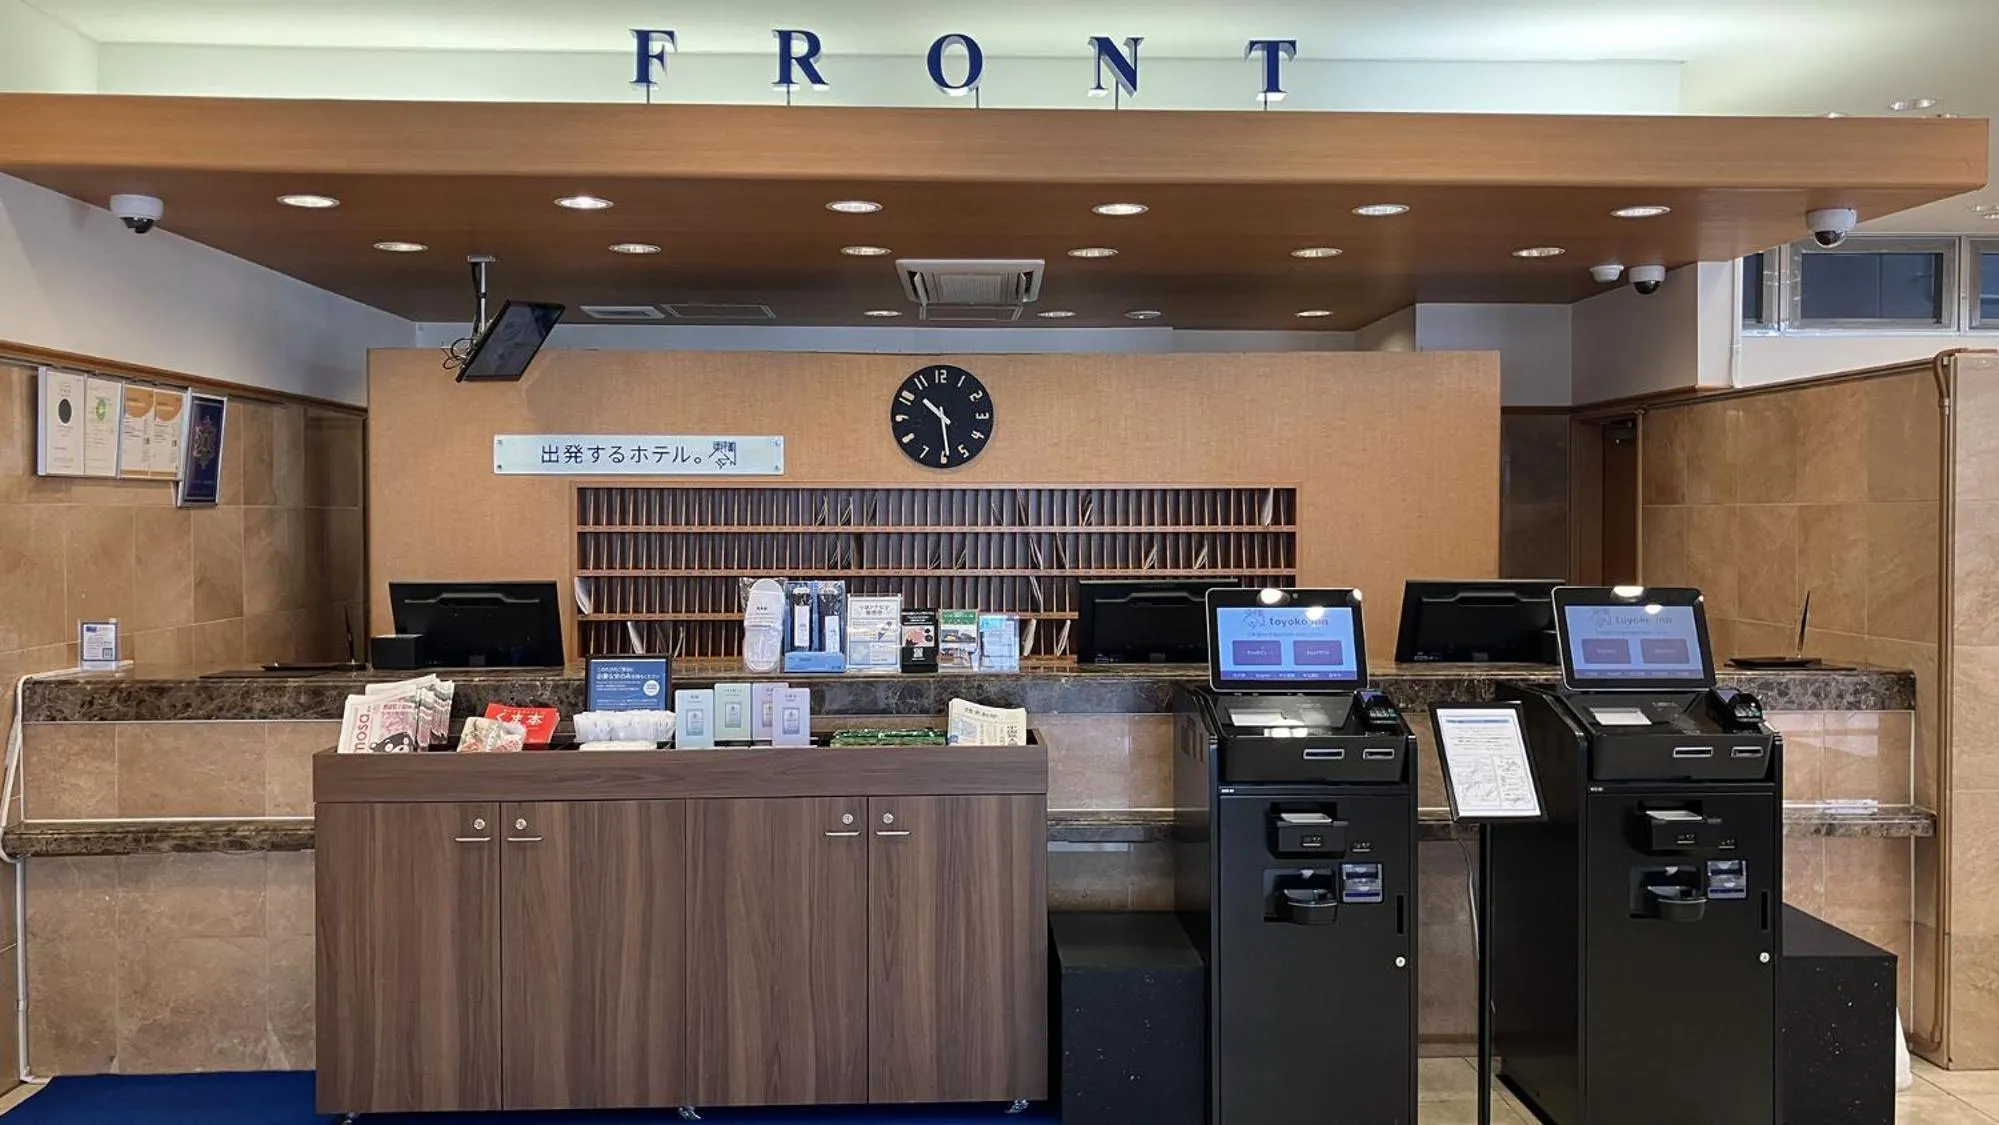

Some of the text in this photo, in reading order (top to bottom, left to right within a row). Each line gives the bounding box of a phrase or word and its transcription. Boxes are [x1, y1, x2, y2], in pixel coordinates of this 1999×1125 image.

[629, 28, 1298, 98] FRONT
[913, 375, 928, 390] 11
[935, 369, 946, 383] 12
[957, 375, 965, 387] 1
[899, 390, 914, 405] 10
[969, 390, 982, 401] 2
[970, 430, 984, 439] 4
[540, 444, 703, 465] 出発するホテル。
[919, 445, 929, 458] 7
[940, 450, 948, 464] 6
[957, 444, 969, 458] 5
